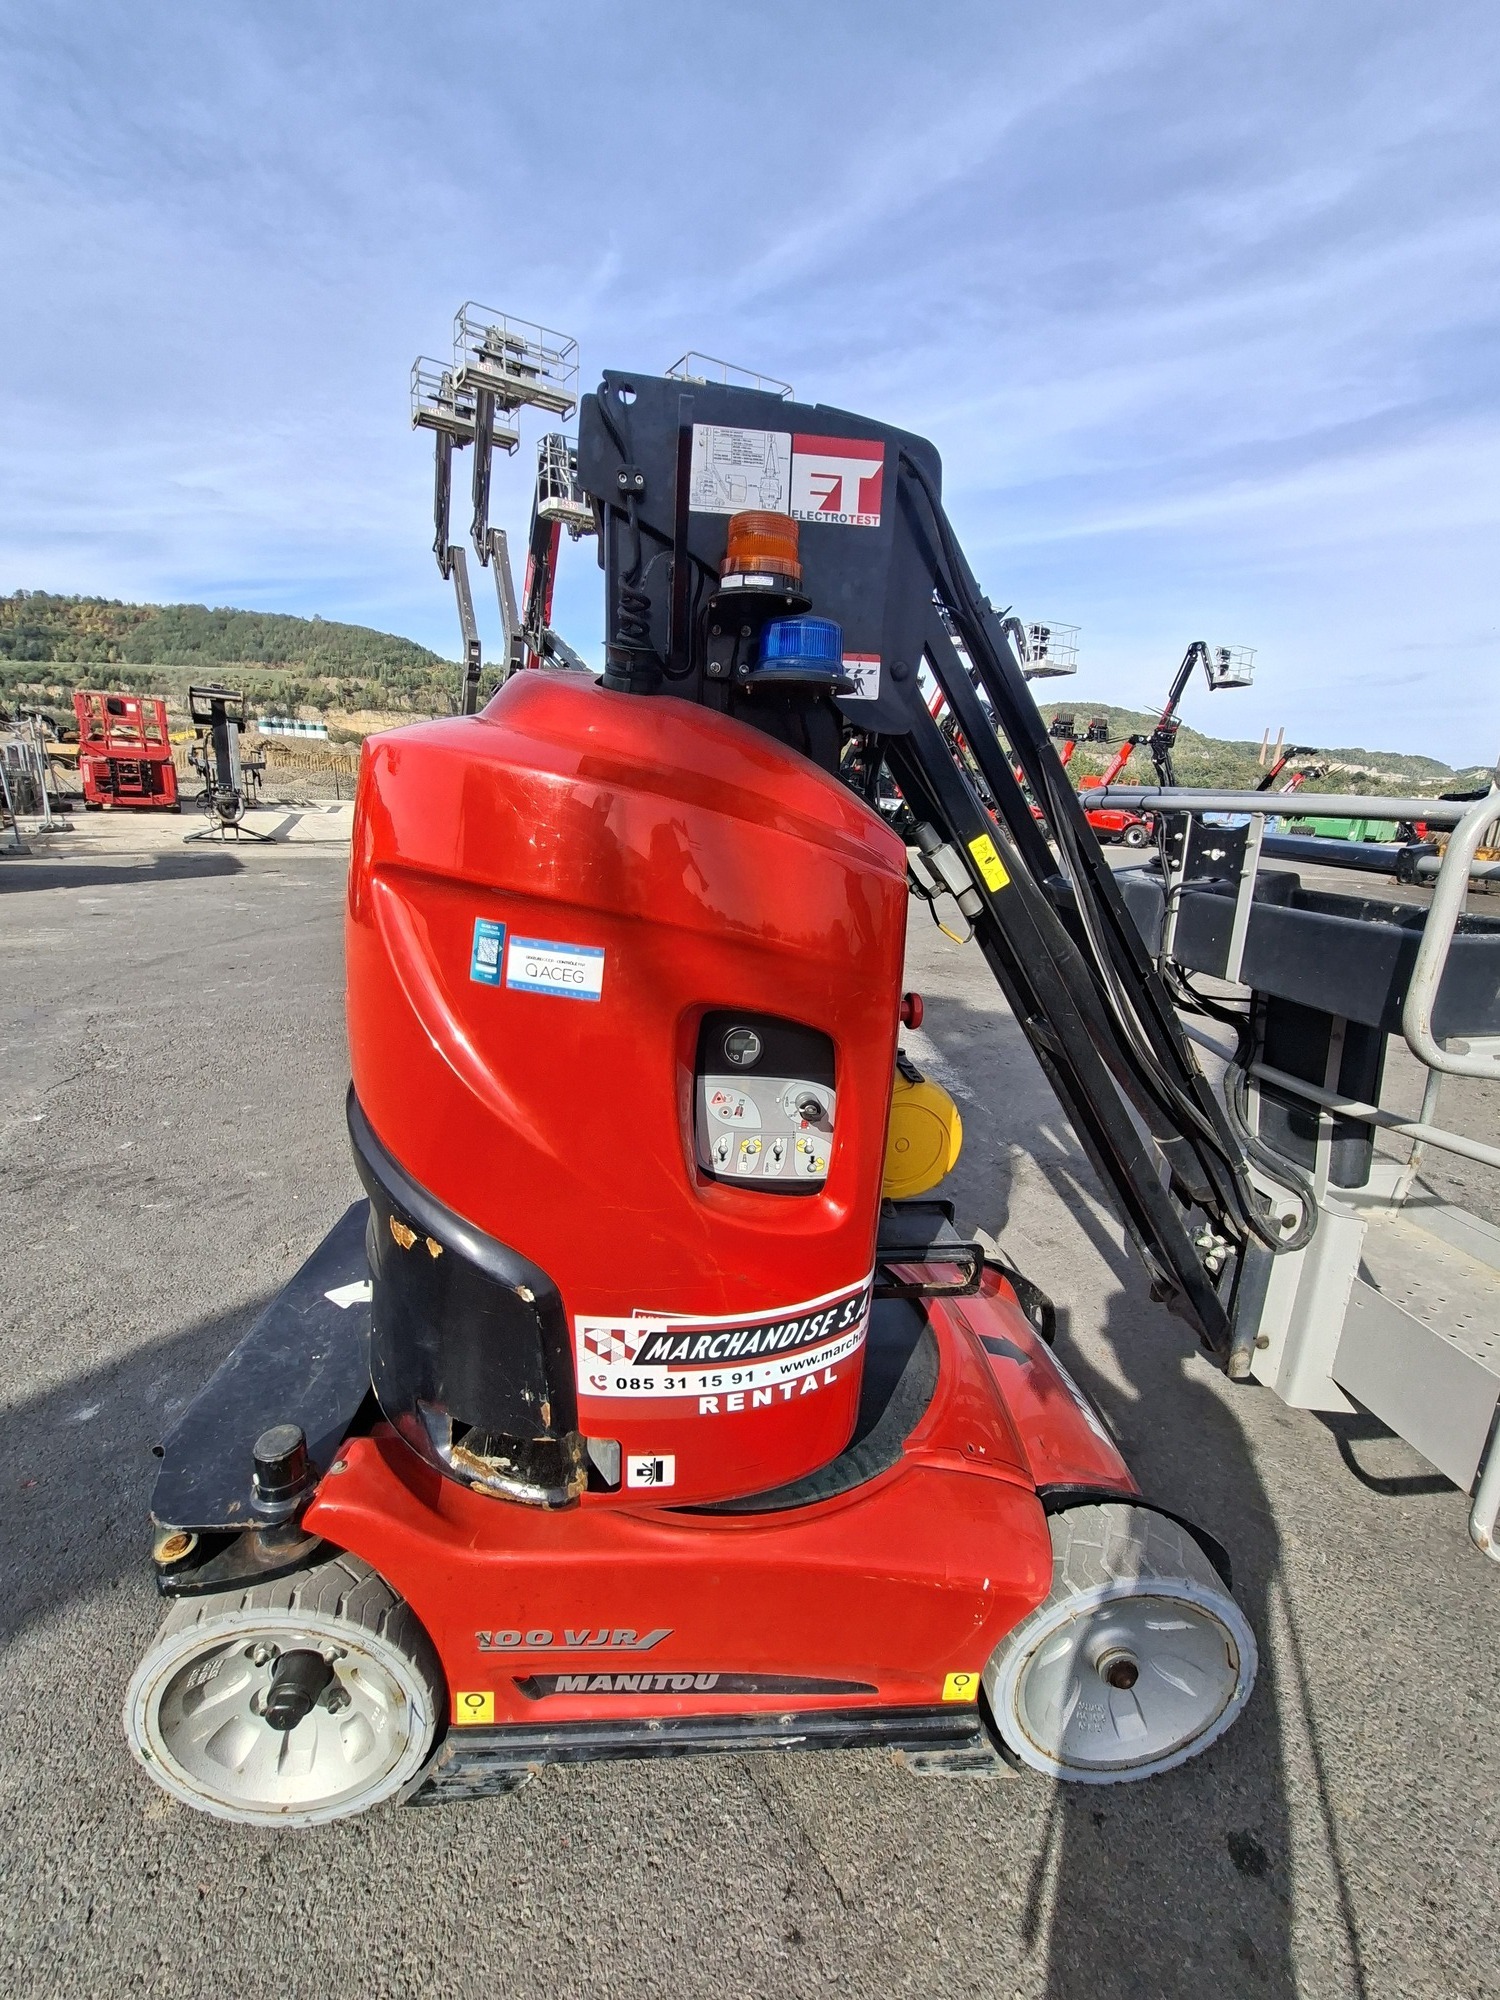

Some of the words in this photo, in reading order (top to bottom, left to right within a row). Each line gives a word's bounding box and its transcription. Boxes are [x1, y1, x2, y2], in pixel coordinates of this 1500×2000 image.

[791, 509, 880, 526] ELECTROTEST
[644, 1308, 838, 1362] MARCHANDISE
[616, 1378, 655, 1390] 085
[664, 1377, 687, 1390] 31
[699, 1375, 722, 1388] 15
[731, 1371, 755, 1385] 91
[699, 1367, 838, 1415] RENTAL
[475, 1629, 554, 1647] 100
[563, 1628, 638, 1646] VJR
[554, 1674, 721, 1692] MANITOU
